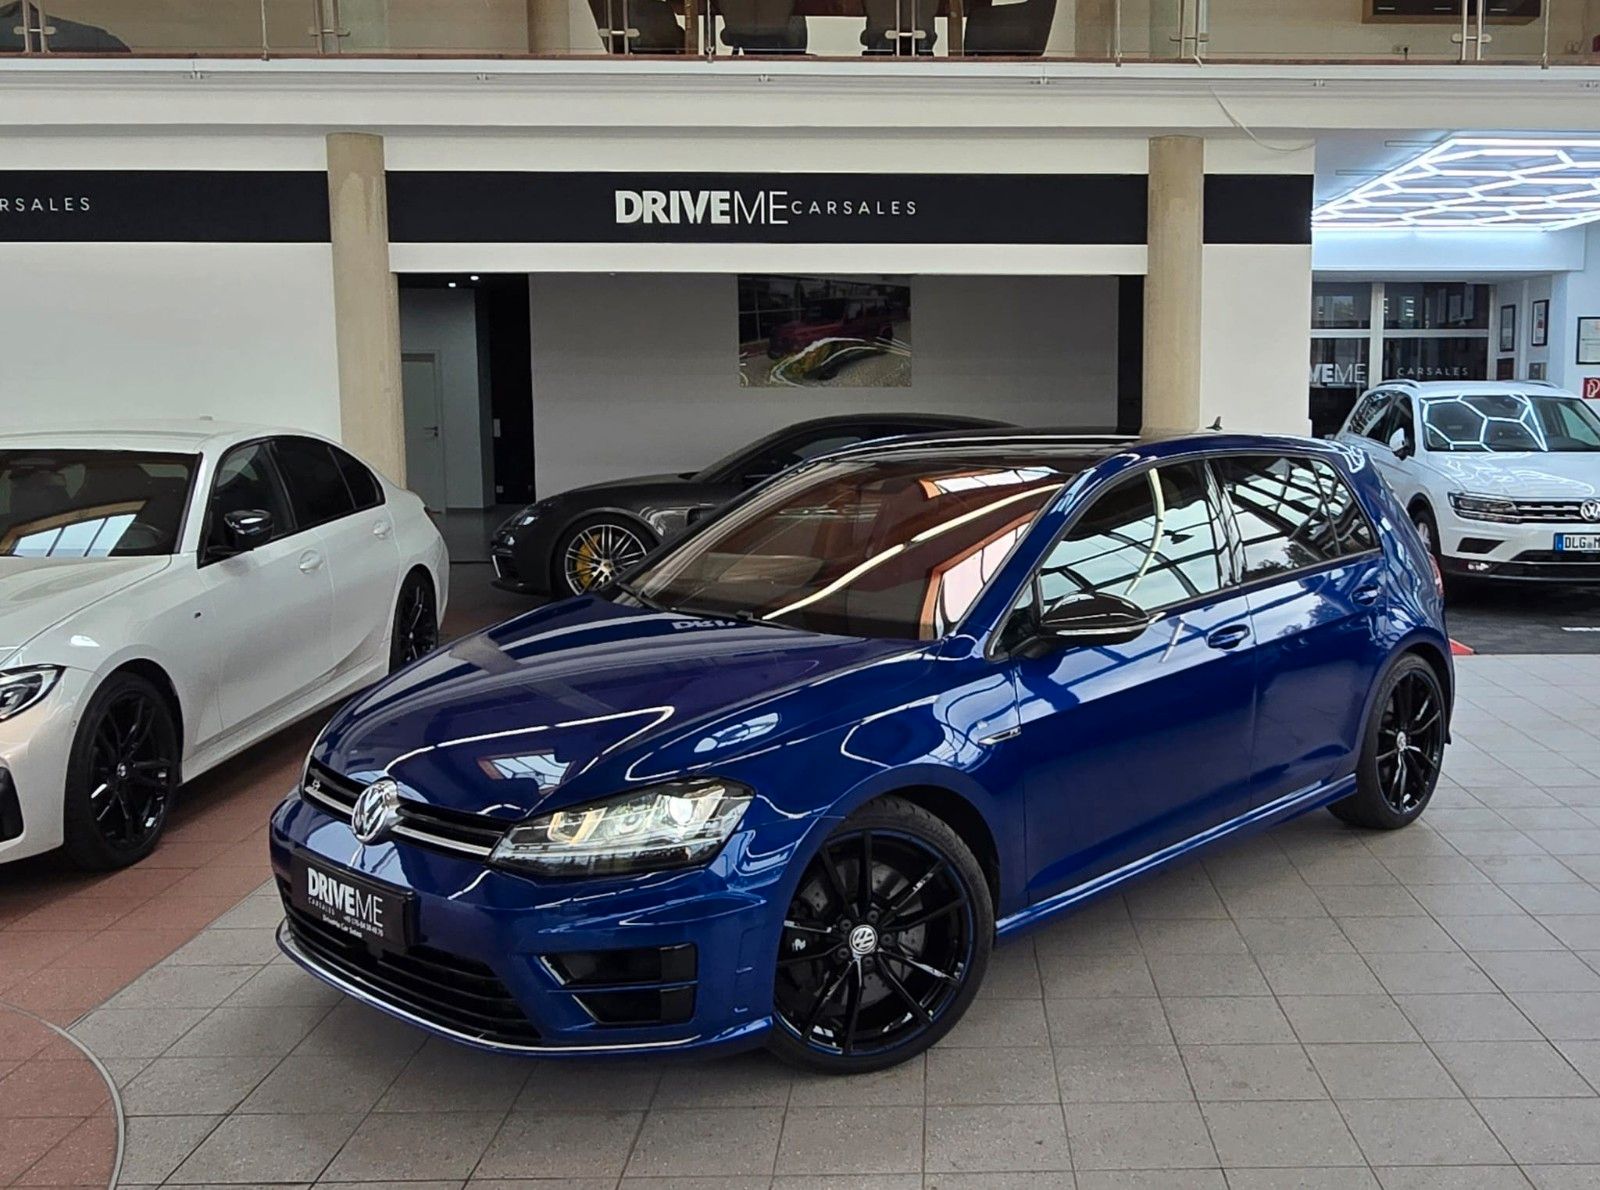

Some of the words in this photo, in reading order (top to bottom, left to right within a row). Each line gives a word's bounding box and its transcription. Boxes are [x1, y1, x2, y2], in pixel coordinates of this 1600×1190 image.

[791, 200, 917, 215] CARSALES
[1396, 366, 1469, 377] CARSALES
[1564, 536, 1587, 549] DLG
